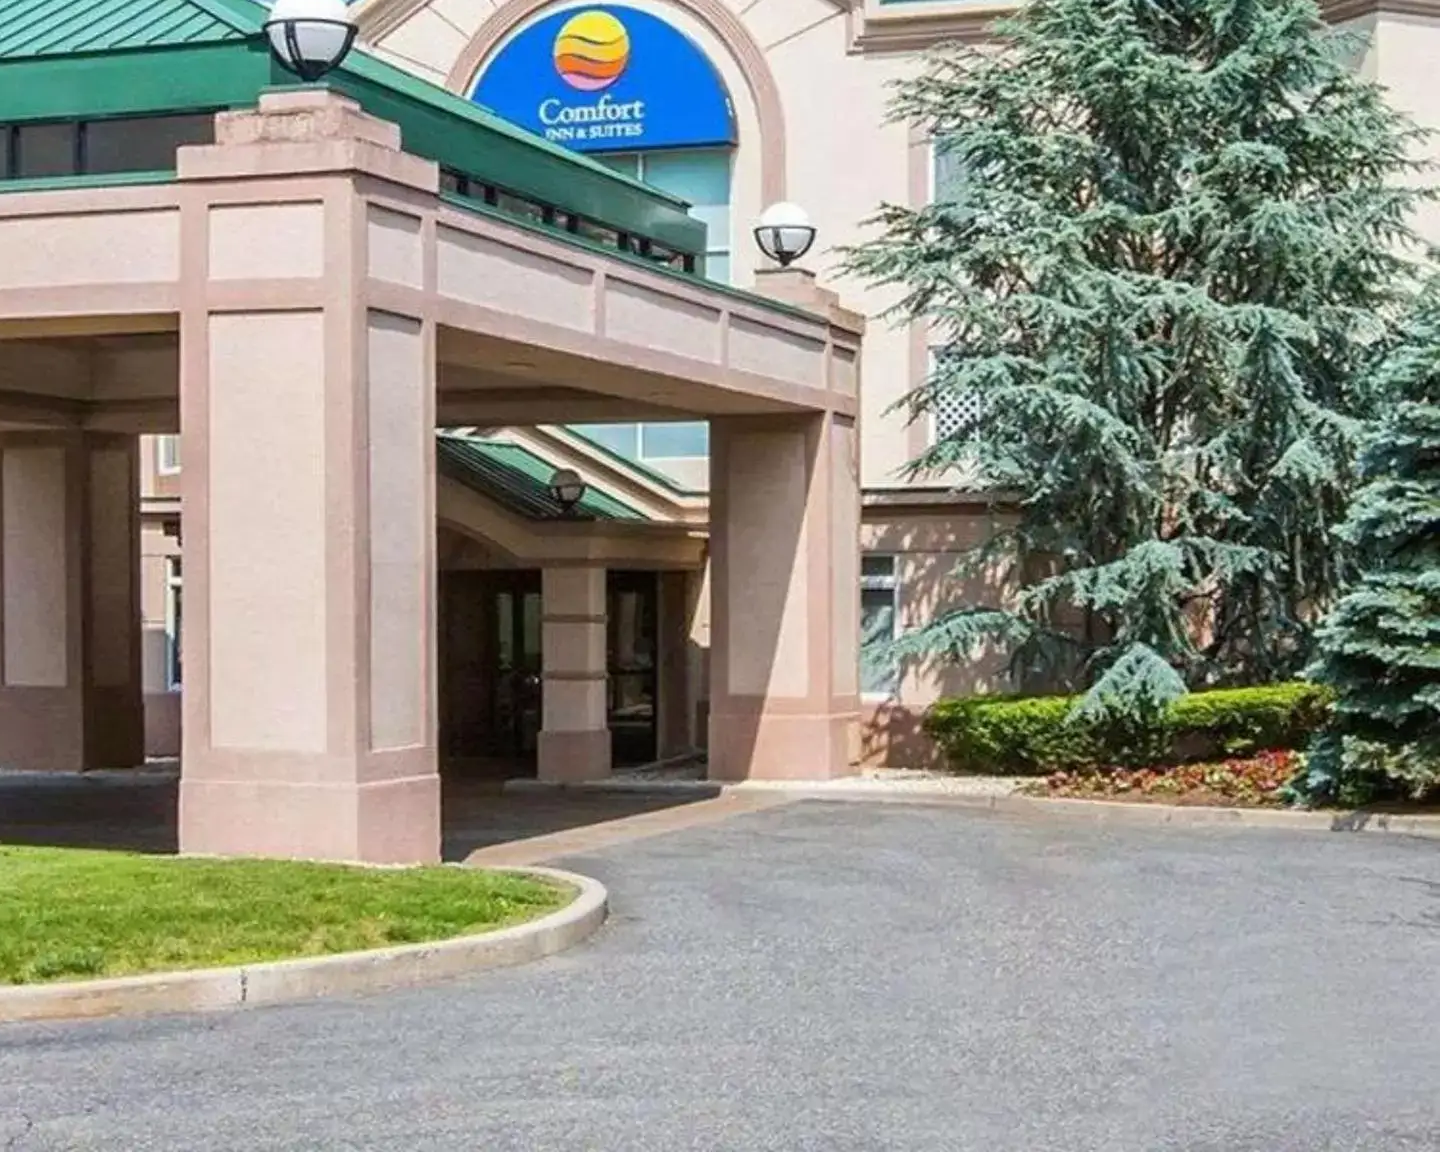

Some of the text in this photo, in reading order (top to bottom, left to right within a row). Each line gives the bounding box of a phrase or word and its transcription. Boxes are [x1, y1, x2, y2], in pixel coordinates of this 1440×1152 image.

[538, 94, 645, 125] Comfort
[545, 123, 643, 140] INN & SUITES
